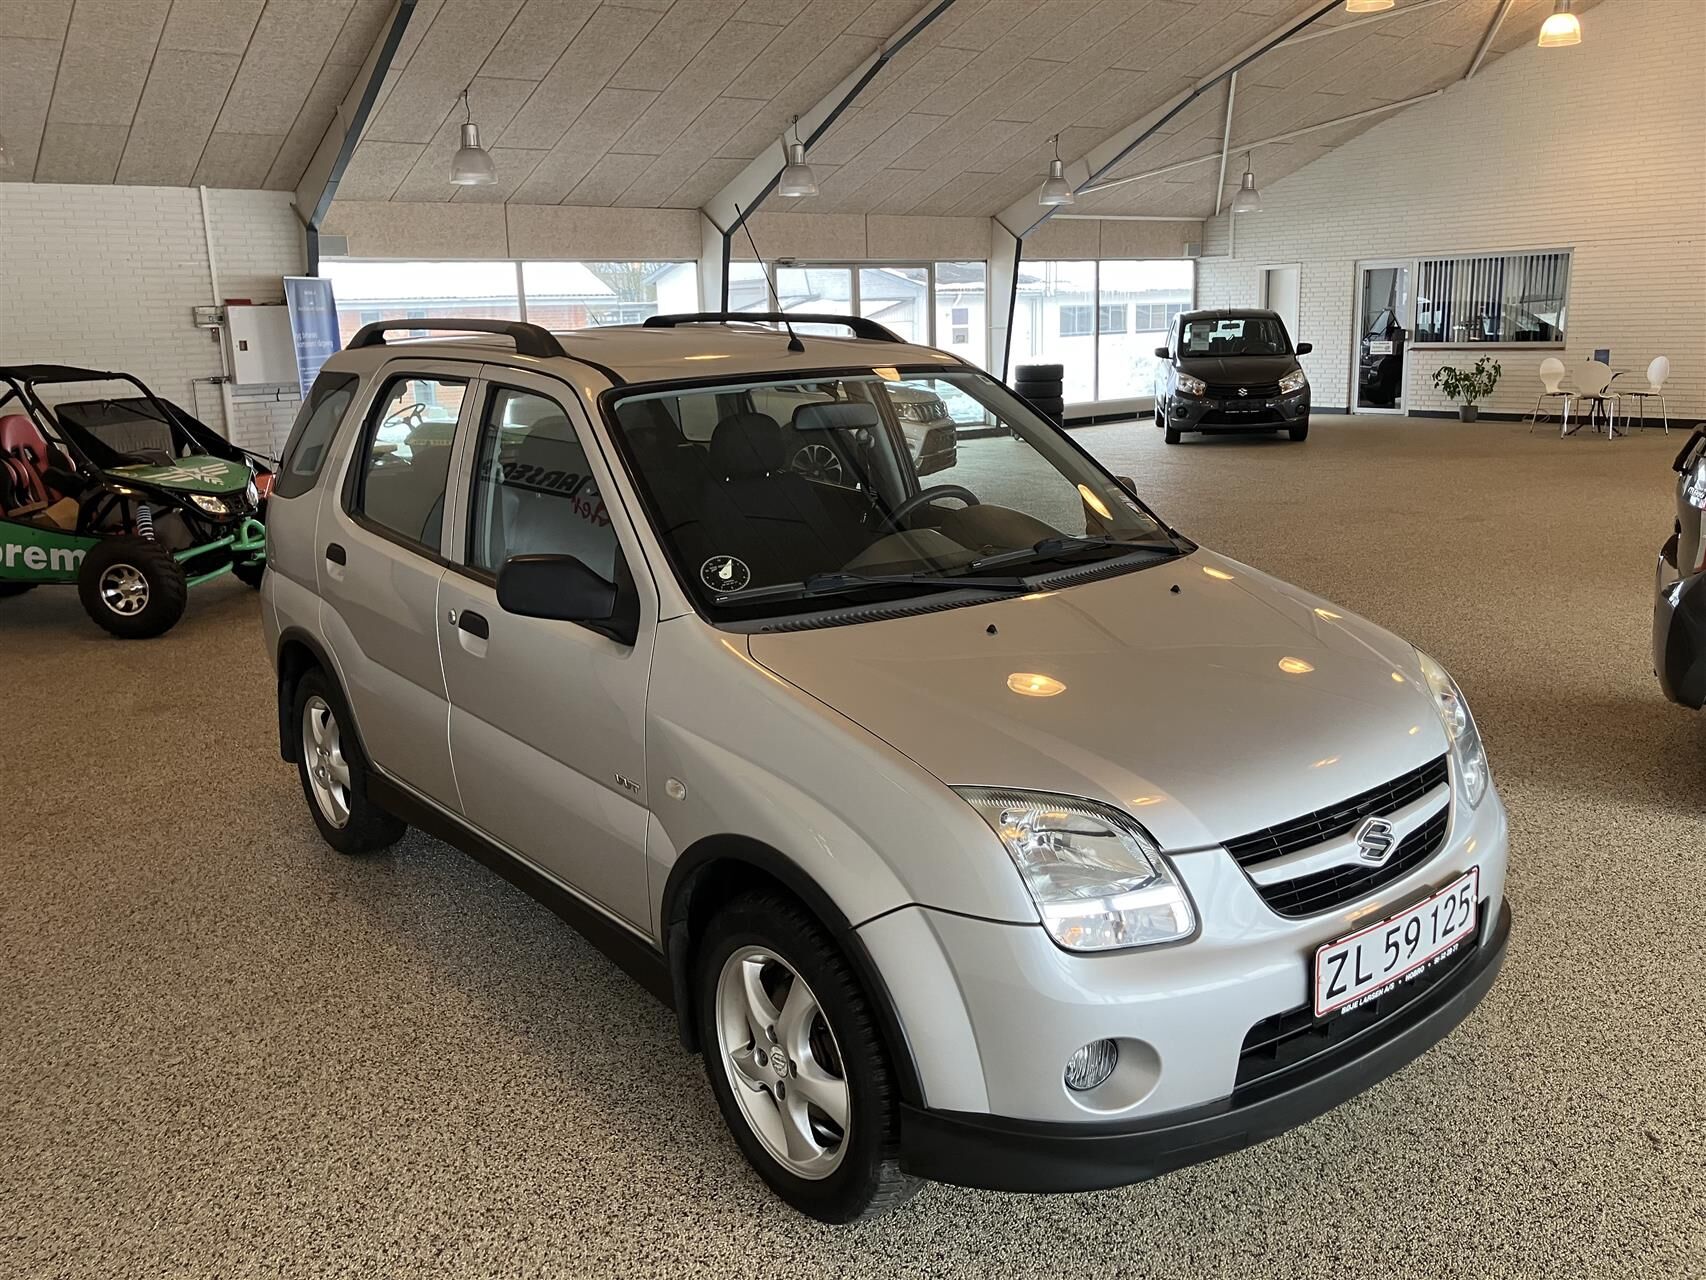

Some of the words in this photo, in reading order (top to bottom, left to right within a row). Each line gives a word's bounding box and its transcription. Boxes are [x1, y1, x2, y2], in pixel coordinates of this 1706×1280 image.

[0, 543, 87, 571] rem
[1326, 945, 1372, 1000] ZL
[1384, 916, 1420, 973] 59
[1431, 884, 1470, 945] 125
